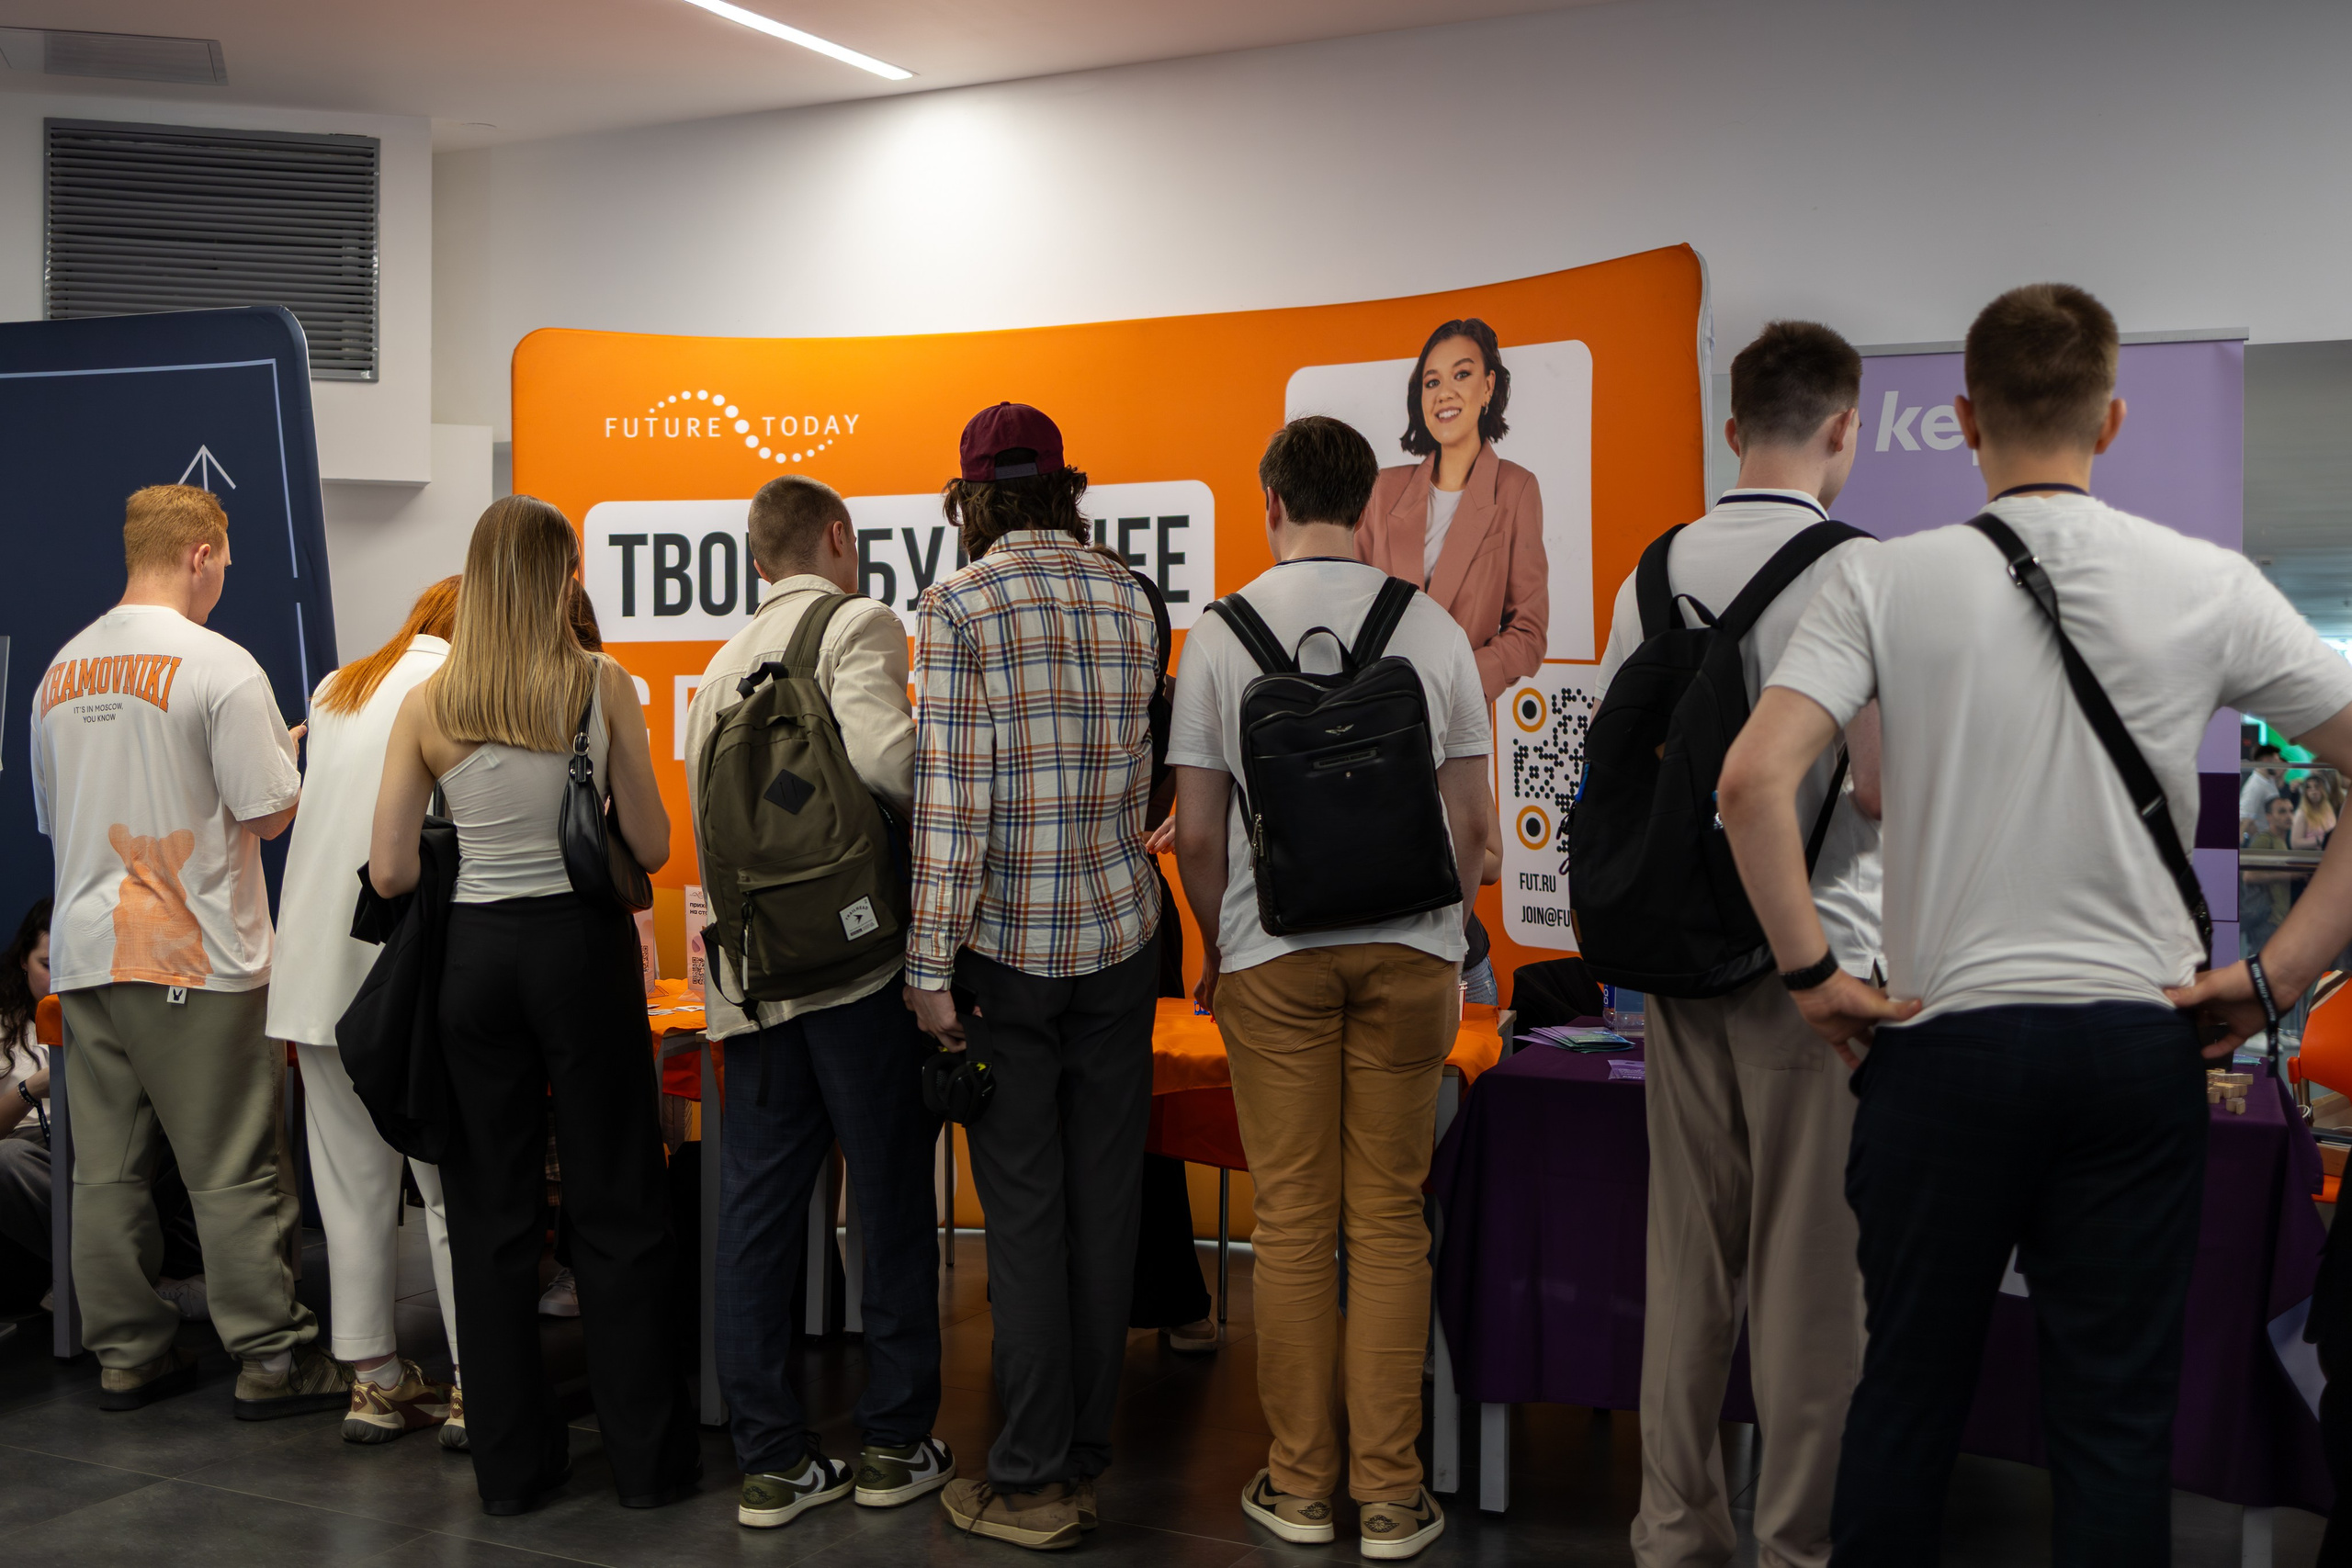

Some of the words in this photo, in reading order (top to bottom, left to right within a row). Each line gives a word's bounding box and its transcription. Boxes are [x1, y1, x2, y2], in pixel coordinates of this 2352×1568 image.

[605, 417, 721, 438] FUTURE
[762, 414, 859, 436] TODAY
[1875, 390, 1978, 466] ke
[857, 514, 1190, 612] БУЕЕ
[40, 654, 183, 724] KHAMOVNIKI
[83, 715, 96, 723] YOU
[97, 714, 117, 722] KNOW
[95, 703, 123, 712] MOSCOW,
[1520, 872, 1556, 893] FUT.RU
